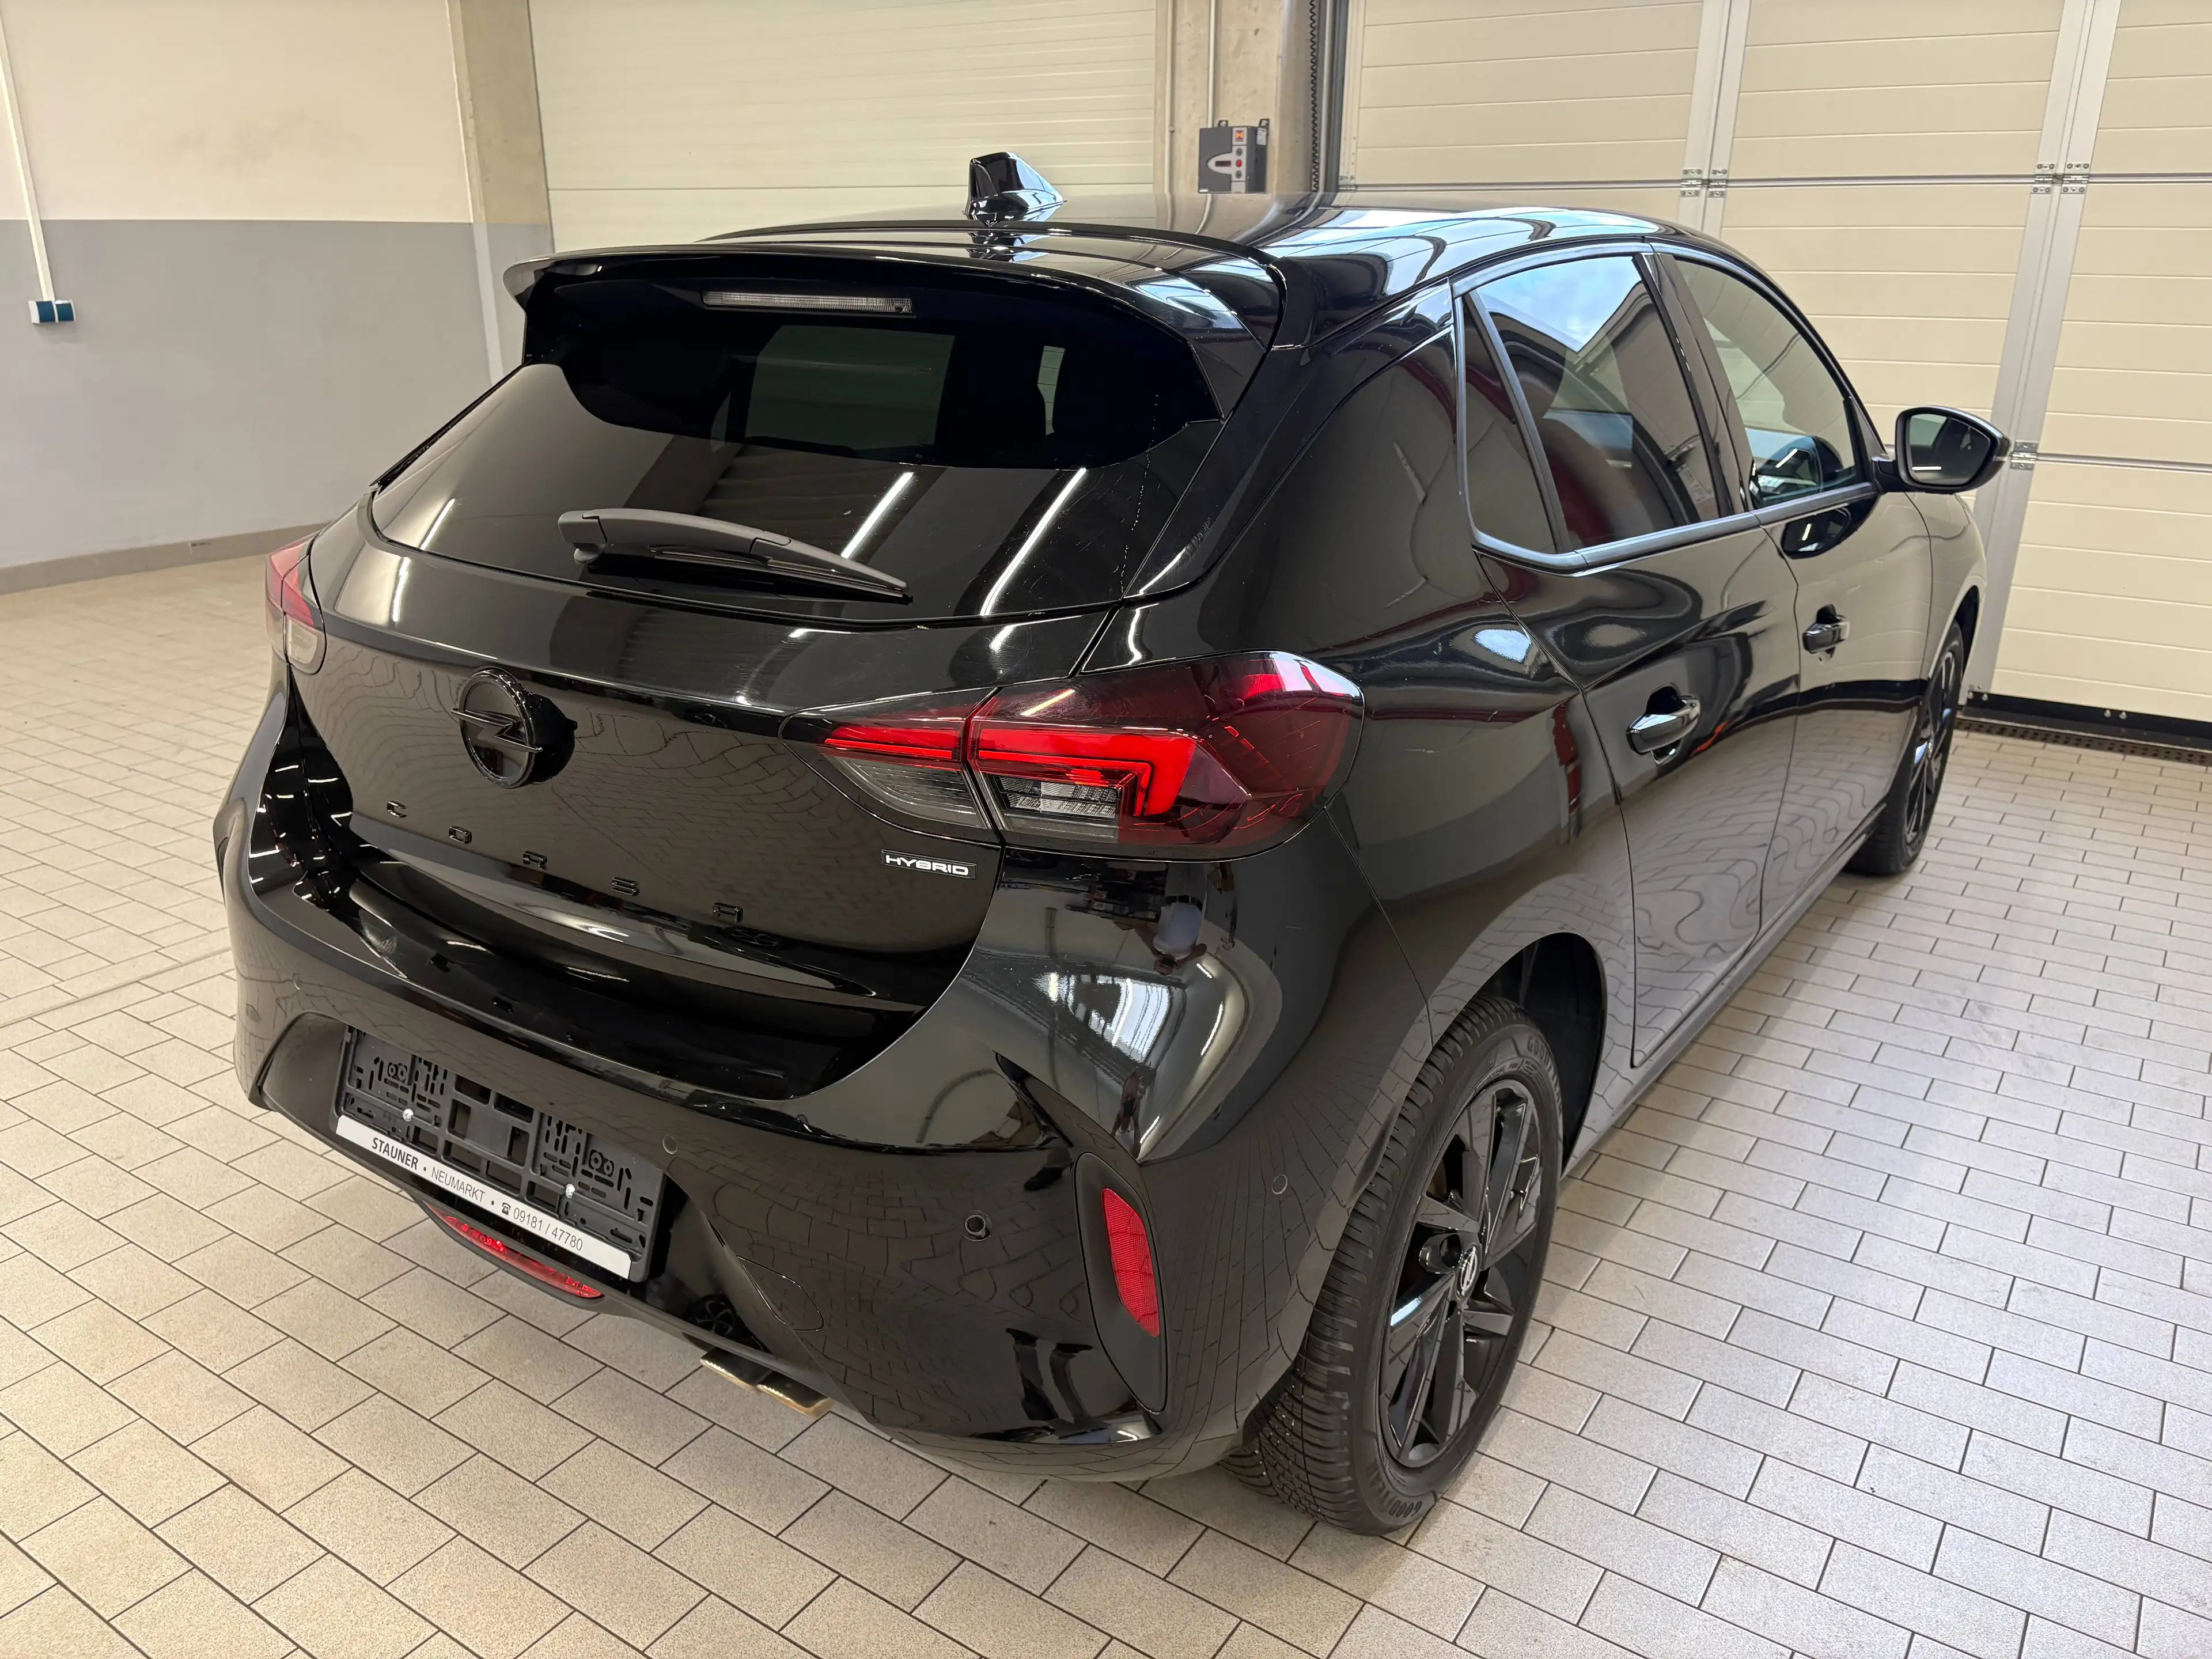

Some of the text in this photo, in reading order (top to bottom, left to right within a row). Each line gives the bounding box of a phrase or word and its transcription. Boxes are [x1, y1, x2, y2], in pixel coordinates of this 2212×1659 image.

[885, 855, 969, 876] HYBRID
[372, 1138, 418, 1170] STAUNER
[431, 1166, 486, 1202] NEUMARKT
[513, 1207, 543, 1231] 09181
[552, 1228, 583, 1251] 47780
